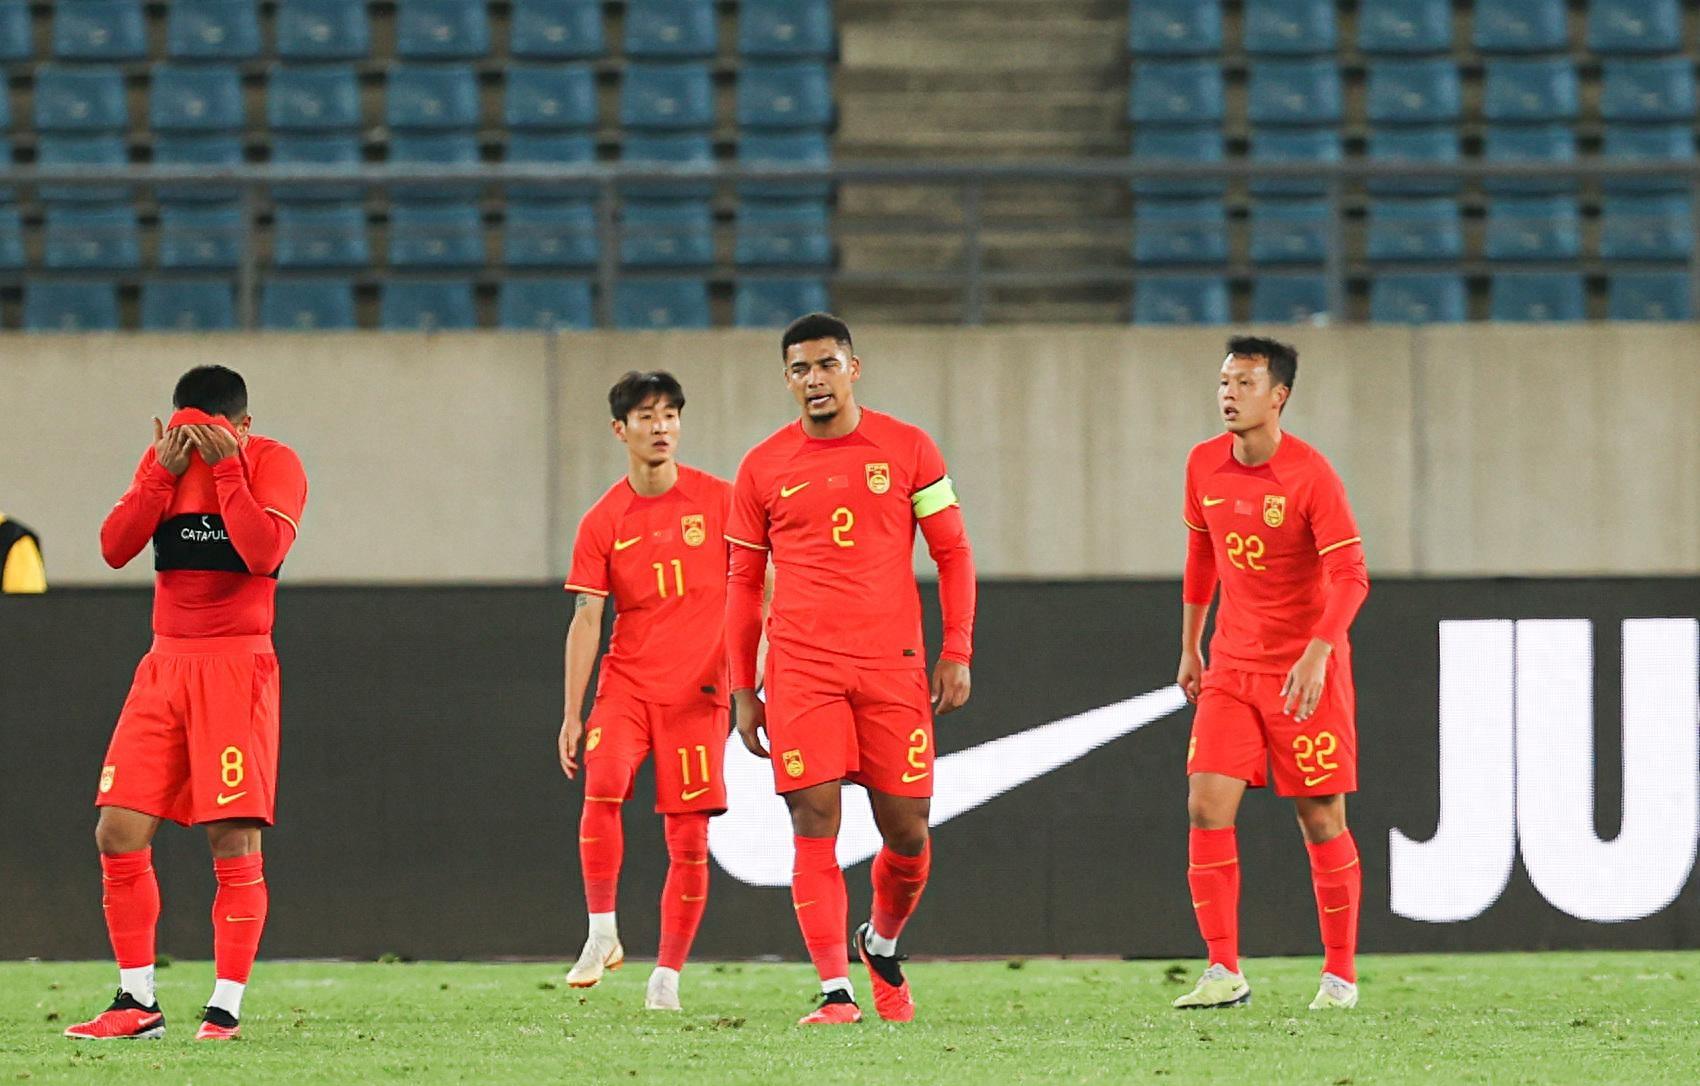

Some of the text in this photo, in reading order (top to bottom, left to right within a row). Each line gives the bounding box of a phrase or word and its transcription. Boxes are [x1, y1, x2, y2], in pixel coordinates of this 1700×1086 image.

[181, 527, 229, 541] CATAUL
[832, 507, 855, 547] 2
[1225, 532, 1266, 571] 22
[652, 559, 684, 598] 11
[220, 746, 244, 787] 8
[677, 745, 710, 785] 11
[908, 728, 928, 769] 2
[1292, 731, 1339, 772] 22
